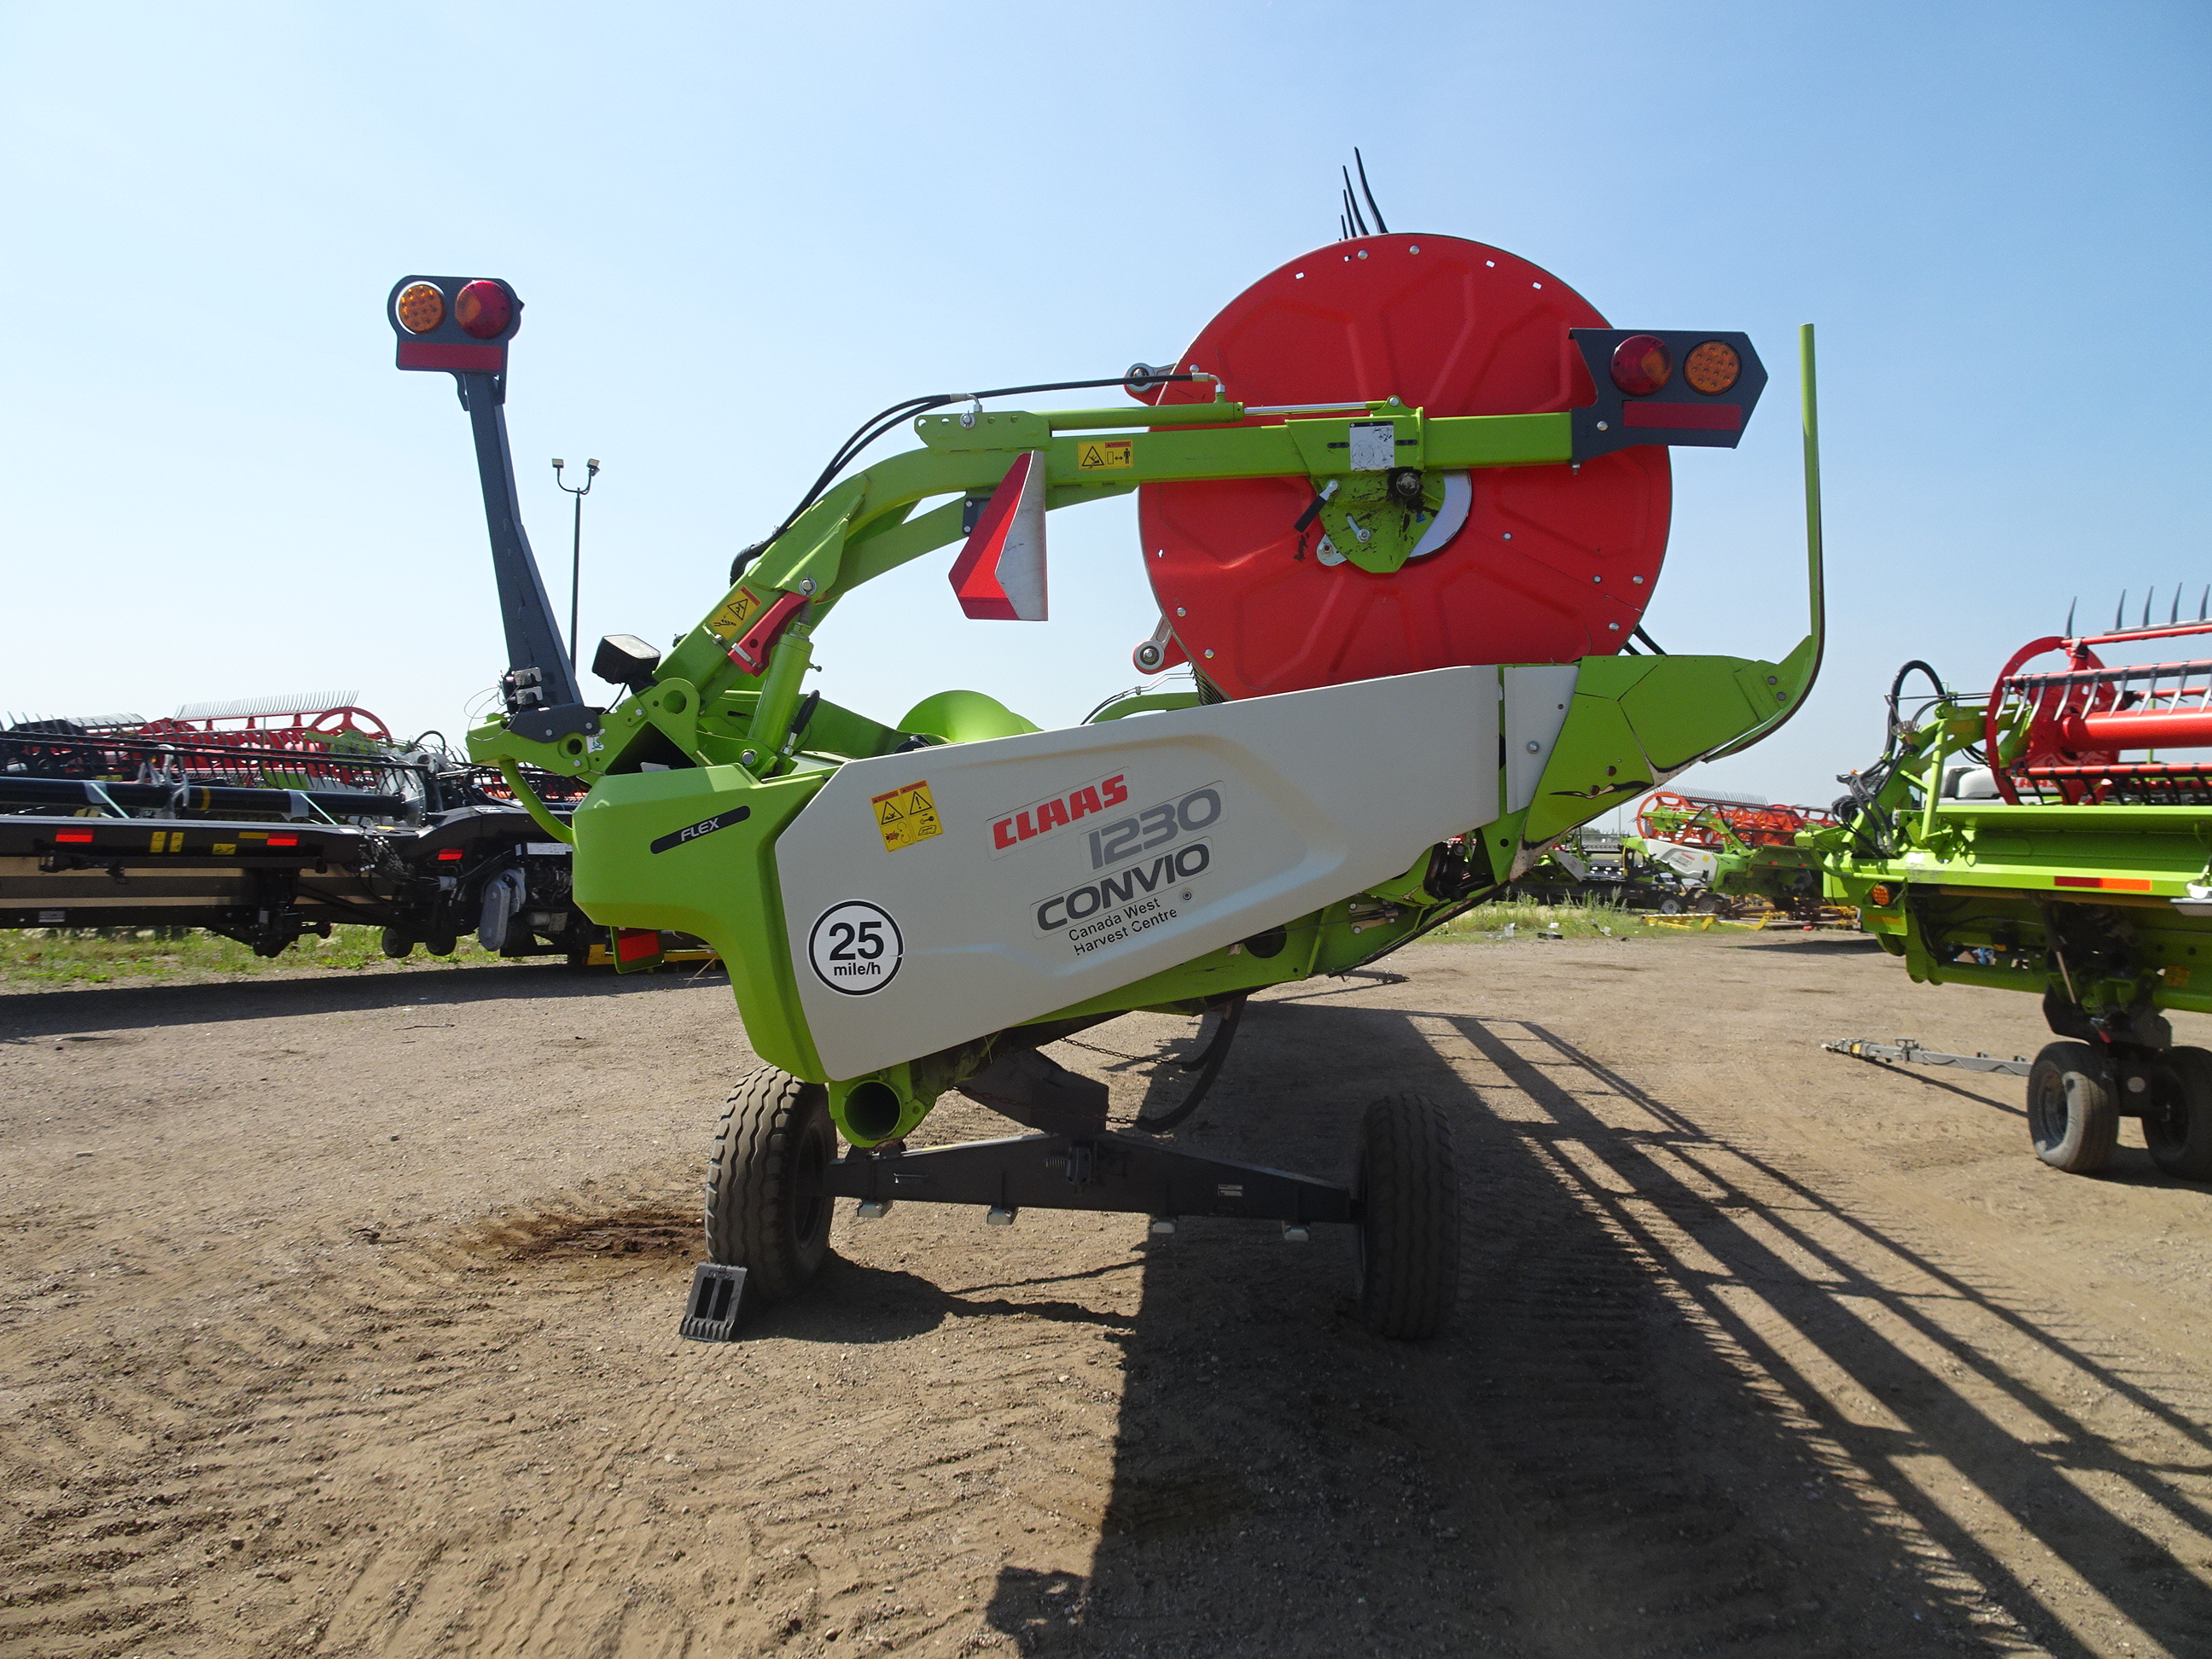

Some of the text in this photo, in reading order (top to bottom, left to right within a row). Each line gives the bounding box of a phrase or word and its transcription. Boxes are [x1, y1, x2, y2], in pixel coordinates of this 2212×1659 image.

[680, 817, 719, 842] FLEX
[993, 774, 1128, 850] CLAAS
[1088, 789, 1221, 870] 1230
[1037, 843, 1210, 931] CONVIO
[829, 921, 885, 961] 25
[1068, 897, 1161, 941] Canada West
[1074, 909, 1178, 956] Harvest Centre
[834, 962, 882, 976] mile/h
